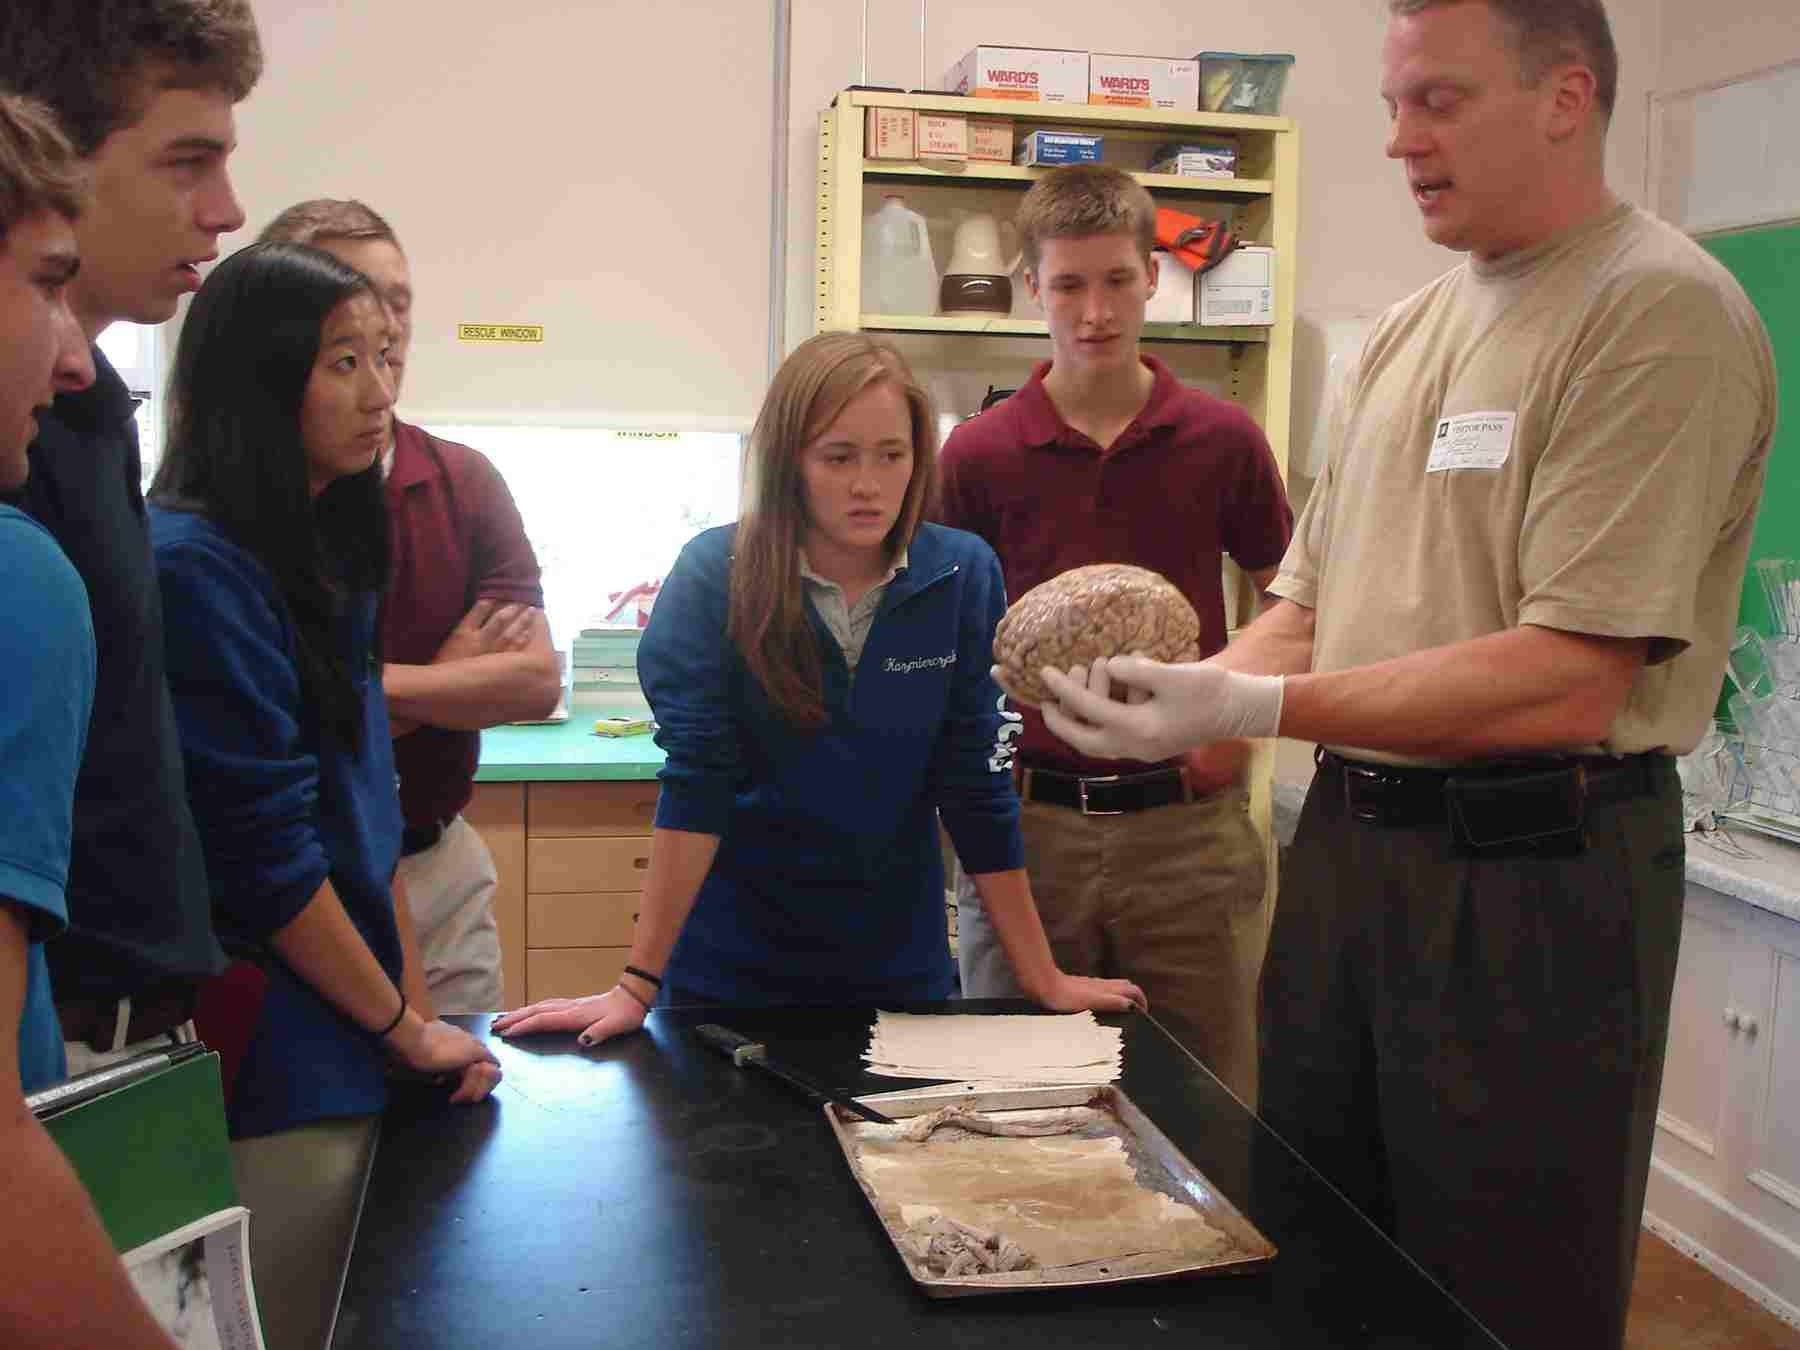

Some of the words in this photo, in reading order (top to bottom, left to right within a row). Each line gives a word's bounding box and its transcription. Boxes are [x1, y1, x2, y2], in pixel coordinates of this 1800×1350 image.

[986, 69, 1039, 84] WARD'S
[1099, 76, 1150, 91] WARD'S
[463, 326, 497, 338] RESCUE
[500, 327, 538, 339] WINDOW
